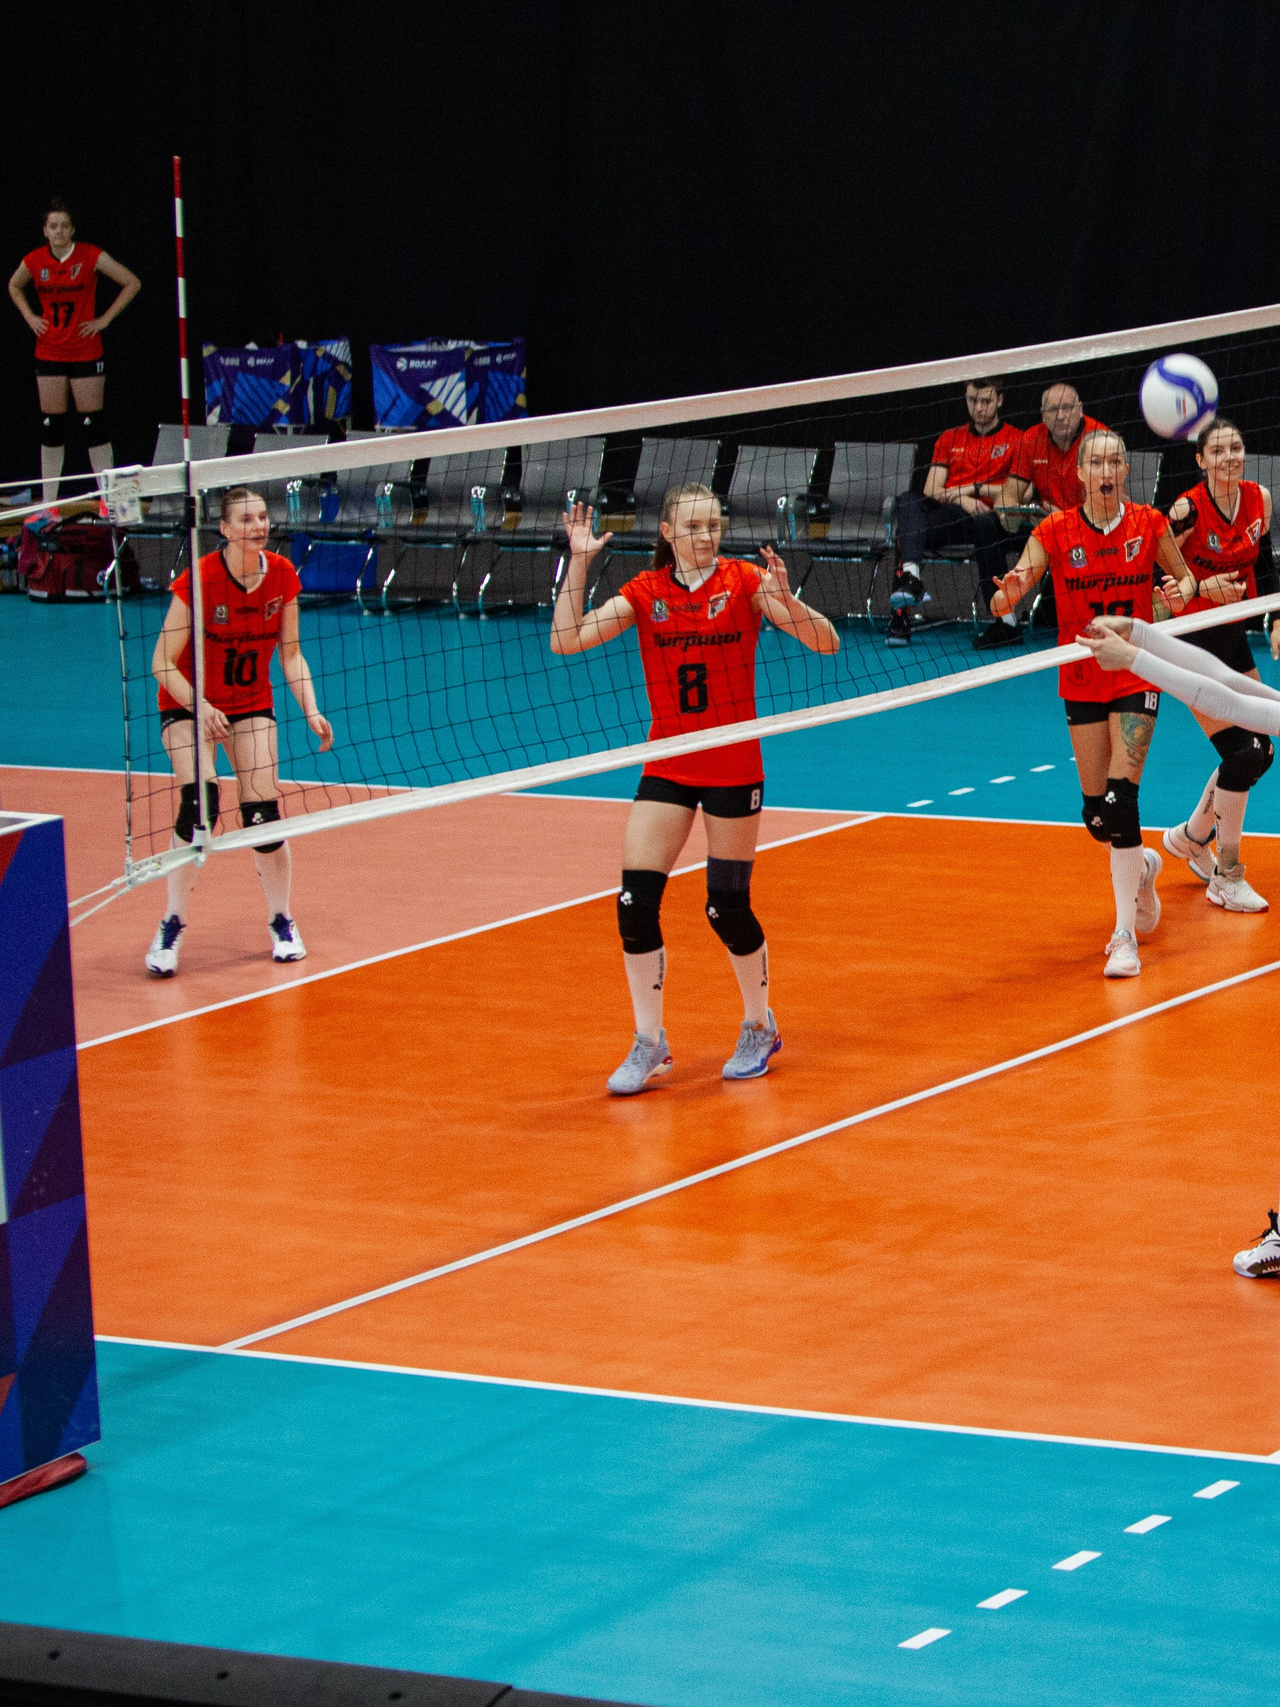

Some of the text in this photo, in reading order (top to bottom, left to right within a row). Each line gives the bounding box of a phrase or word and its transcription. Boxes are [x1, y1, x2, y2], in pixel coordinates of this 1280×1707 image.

[50, 301, 75, 329] 17
[223, 648, 259, 687] 10
[678, 664, 708, 713] 8
[1144, 691, 1158, 711] 18
[750, 788, 761, 811] 8
